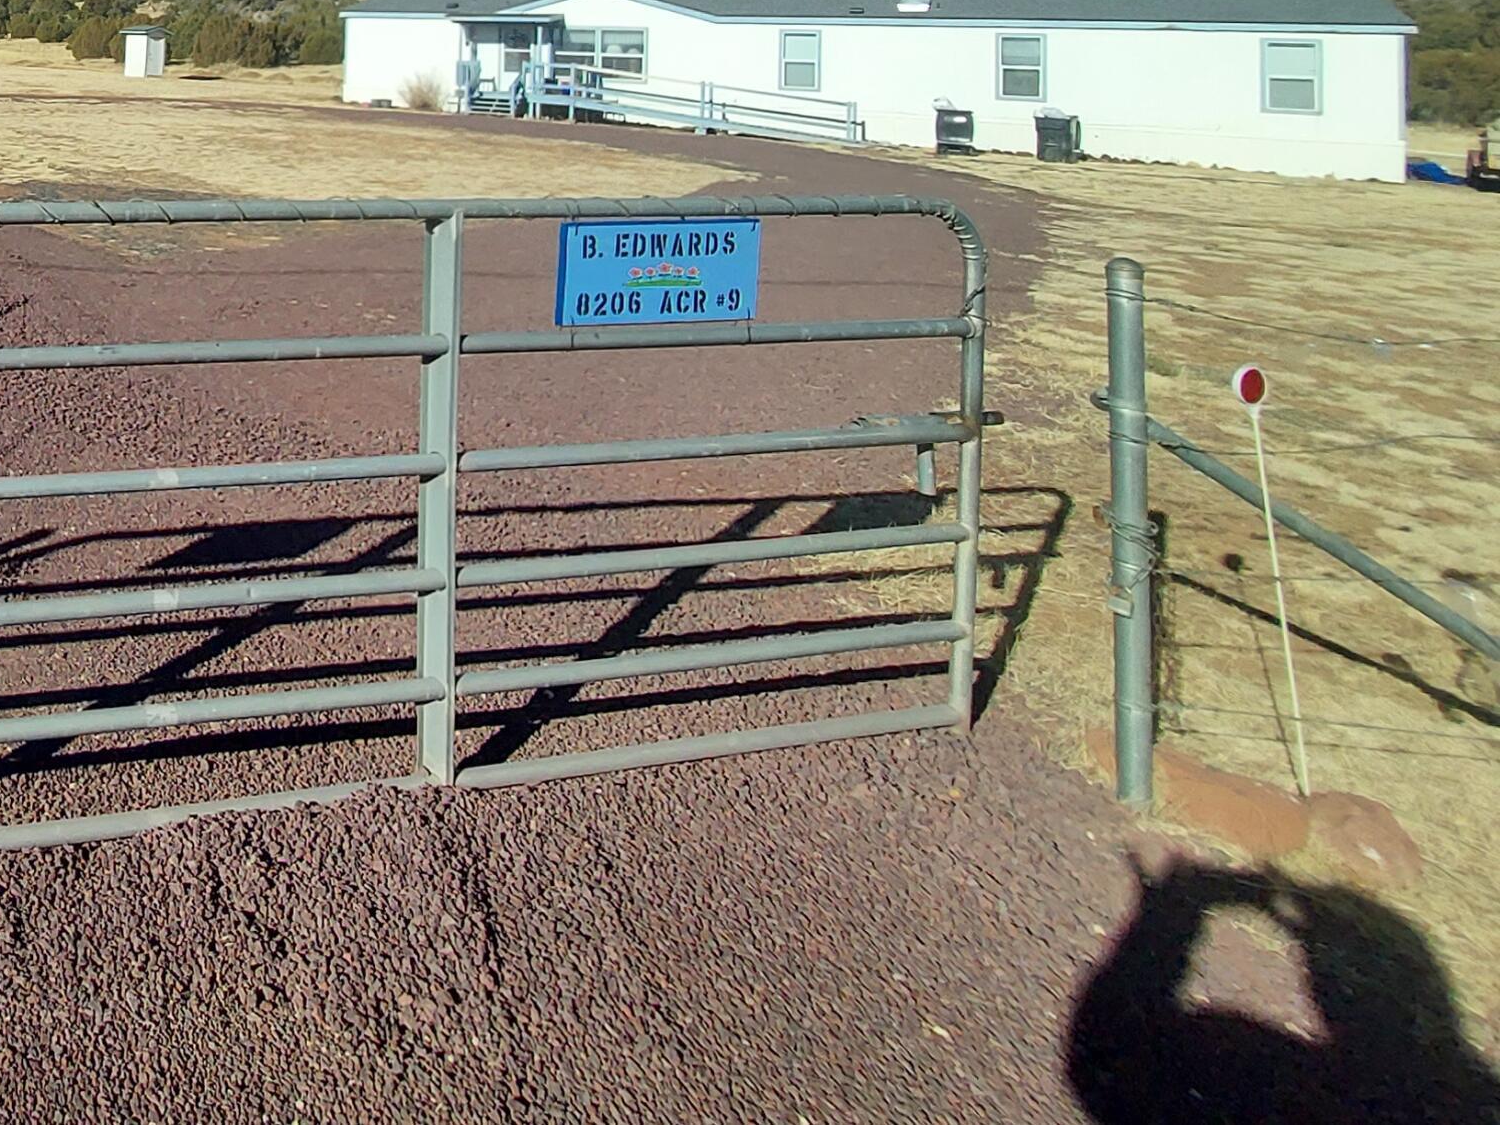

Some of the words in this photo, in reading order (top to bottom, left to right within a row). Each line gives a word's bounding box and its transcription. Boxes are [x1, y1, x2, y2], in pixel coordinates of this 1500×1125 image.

[582, 235, 603, 259] B.
[614, 231, 736, 258] EDWARDS
[576, 290, 642, 316] 8206
[660, 289, 707, 314] ACR
[716, 288, 741, 311] #9
